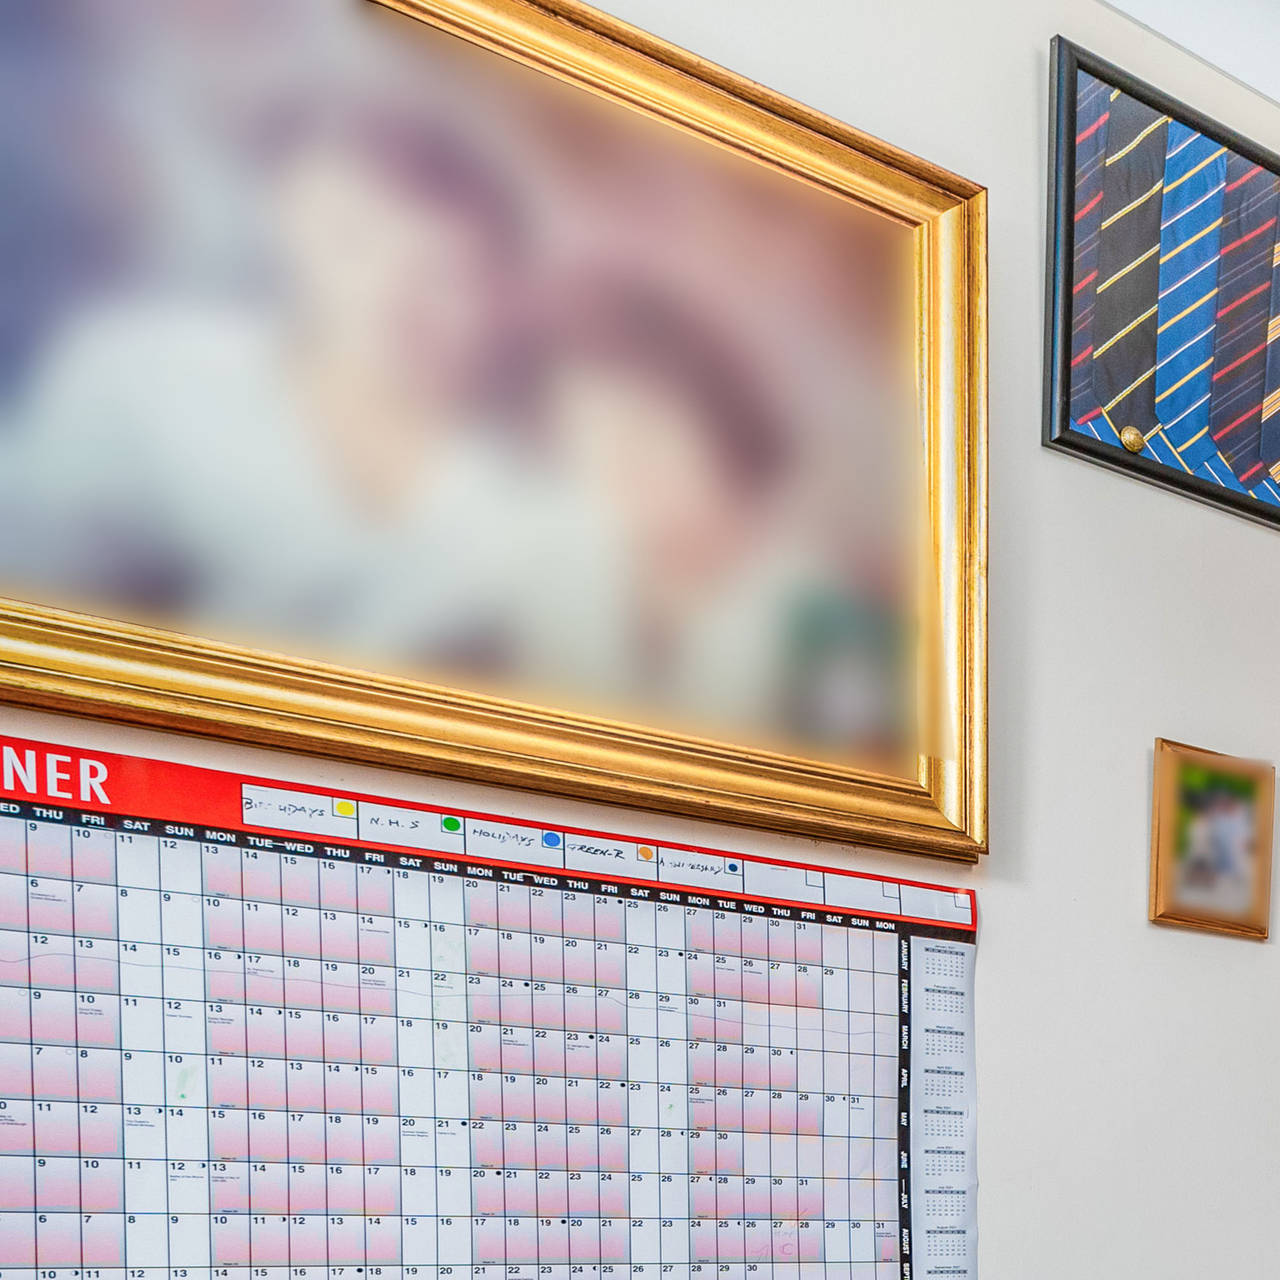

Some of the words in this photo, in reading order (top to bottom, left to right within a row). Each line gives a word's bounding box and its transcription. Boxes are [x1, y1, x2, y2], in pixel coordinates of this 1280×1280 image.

[2, 746, 111, 804] NER
[32, 807, 63, 820] THU
[81, 815, 105, 826] FRI
[123, 820, 151, 832] SAT
[165, 825, 194, 837] SUN
[205, 830, 236, 842] MON
[247, 837, 273, 848] TUE
[284, 841, 314, 854] WED
[324, 847, 350, 858] THU
[365, 853, 384, 863] FRI
[400, 857, 422, 868] SAT
[433, 862, 458, 873] SUN
[467, 866, 493, 878] MON
[502, 871, 524, 882] TUE
[533, 875, 558, 887] WED
[567, 879, 589, 890] THU
[601, 884, 618, 895] FRI
[630, 888, 650, 898] SAT
[660, 891, 680, 902] SUN
[688, 895, 710, 906] MON
[718, 900, 736, 910] TUE
[744, 904, 765, 915] WED
[772, 907, 791, 918] THU
[801, 911, 815, 921] FRI
[826, 914, 843, 924] SAT
[851, 918, 870, 928] SUN
[876, 921, 895, 931] MON
[466, 880, 478, 889] 20
[500, 885, 512, 894] 21
[531, 889, 544, 898] 22
[564, 893, 577, 901] 23
